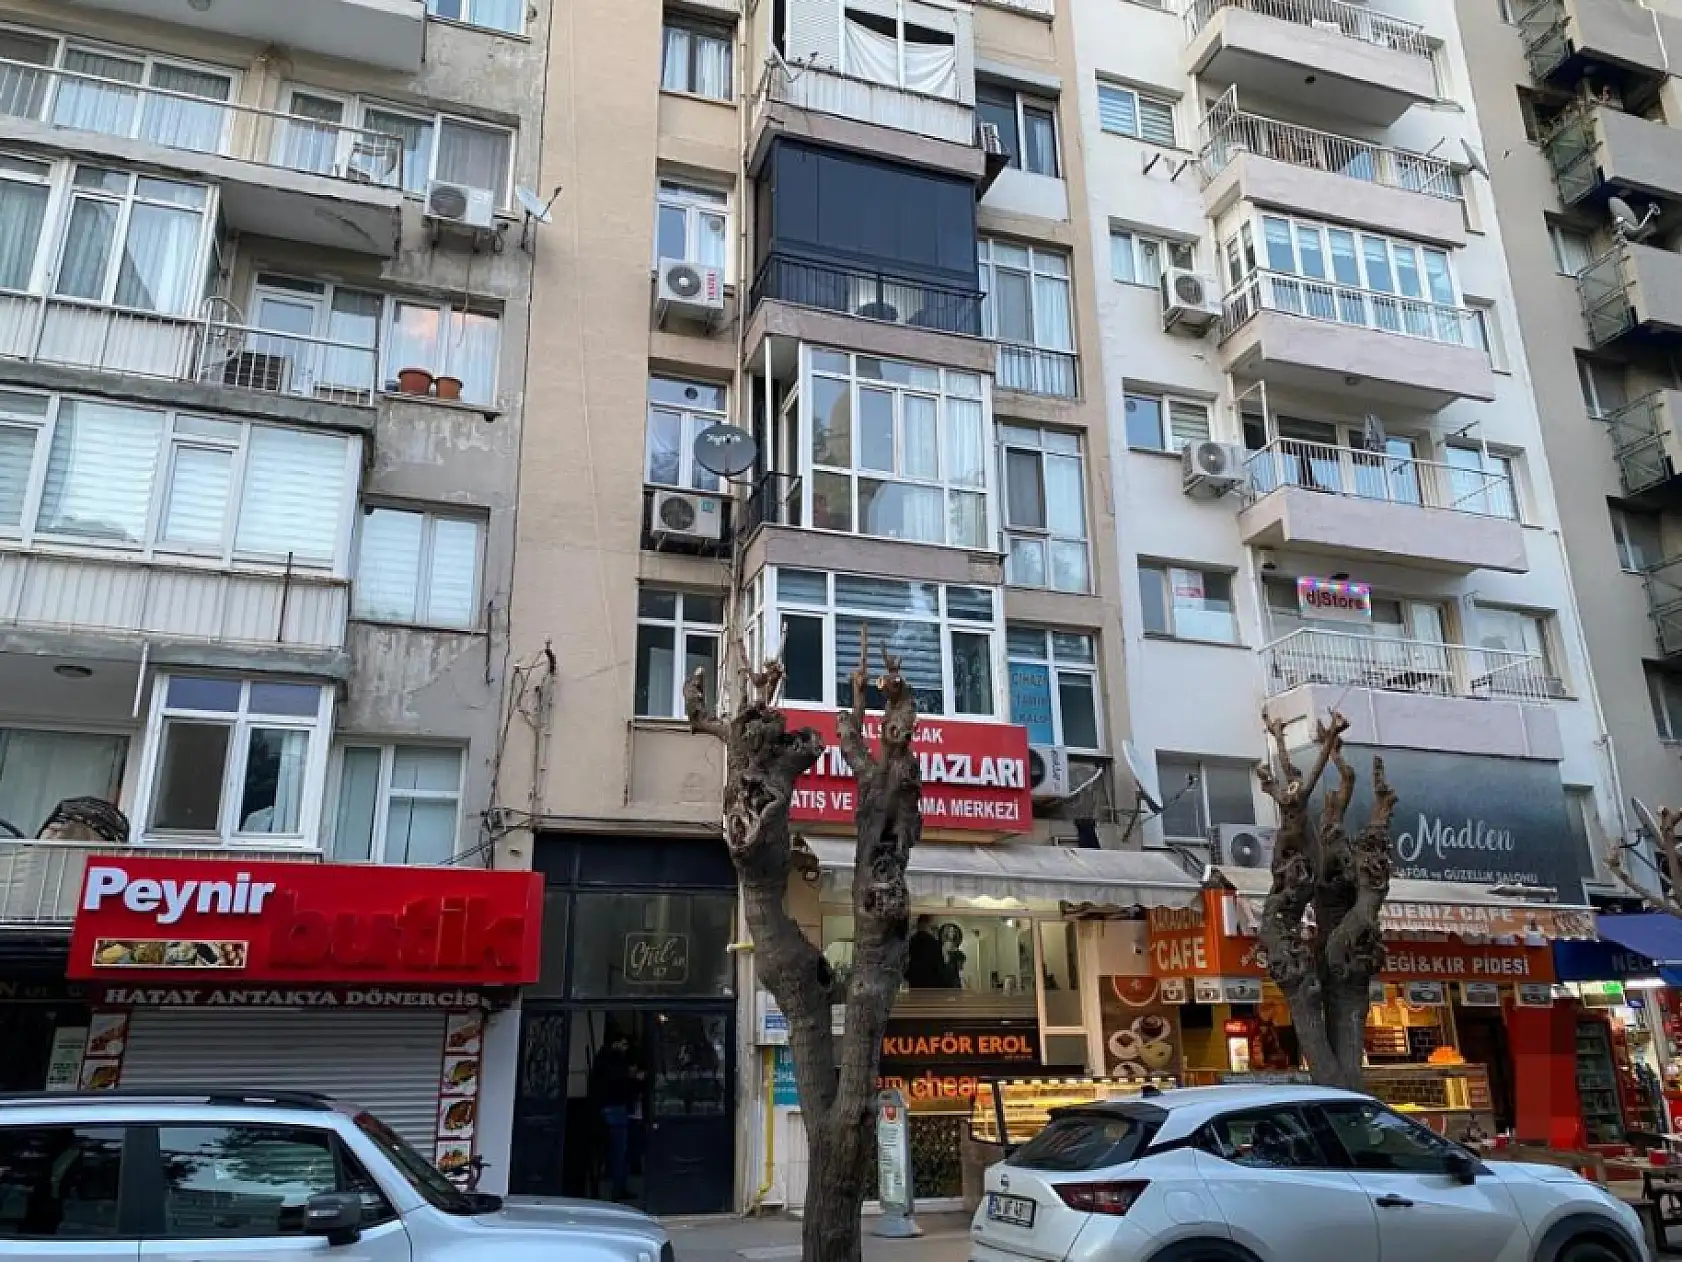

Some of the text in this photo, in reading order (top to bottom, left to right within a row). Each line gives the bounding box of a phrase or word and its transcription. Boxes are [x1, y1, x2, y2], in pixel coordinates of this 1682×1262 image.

[791, 790, 853, 814] ATIŞ VE
[951, 796, 1019, 820] MERKEZİ
[1397, 812, 1515, 862] Madlen
[84, 866, 275, 923] Peynir
[1459, 906, 1515, 922] CAFE
[272, 890, 525, 970] butik
[1157, 936, 1208, 972] CAFE
[1473, 952, 1531, 976] PİDESİ
[104, 988, 201, 1006] HATAY
[207, 987, 336, 1006] ANTAKYA
[883, 1032, 1033, 1056] KUAFÖR EROL
